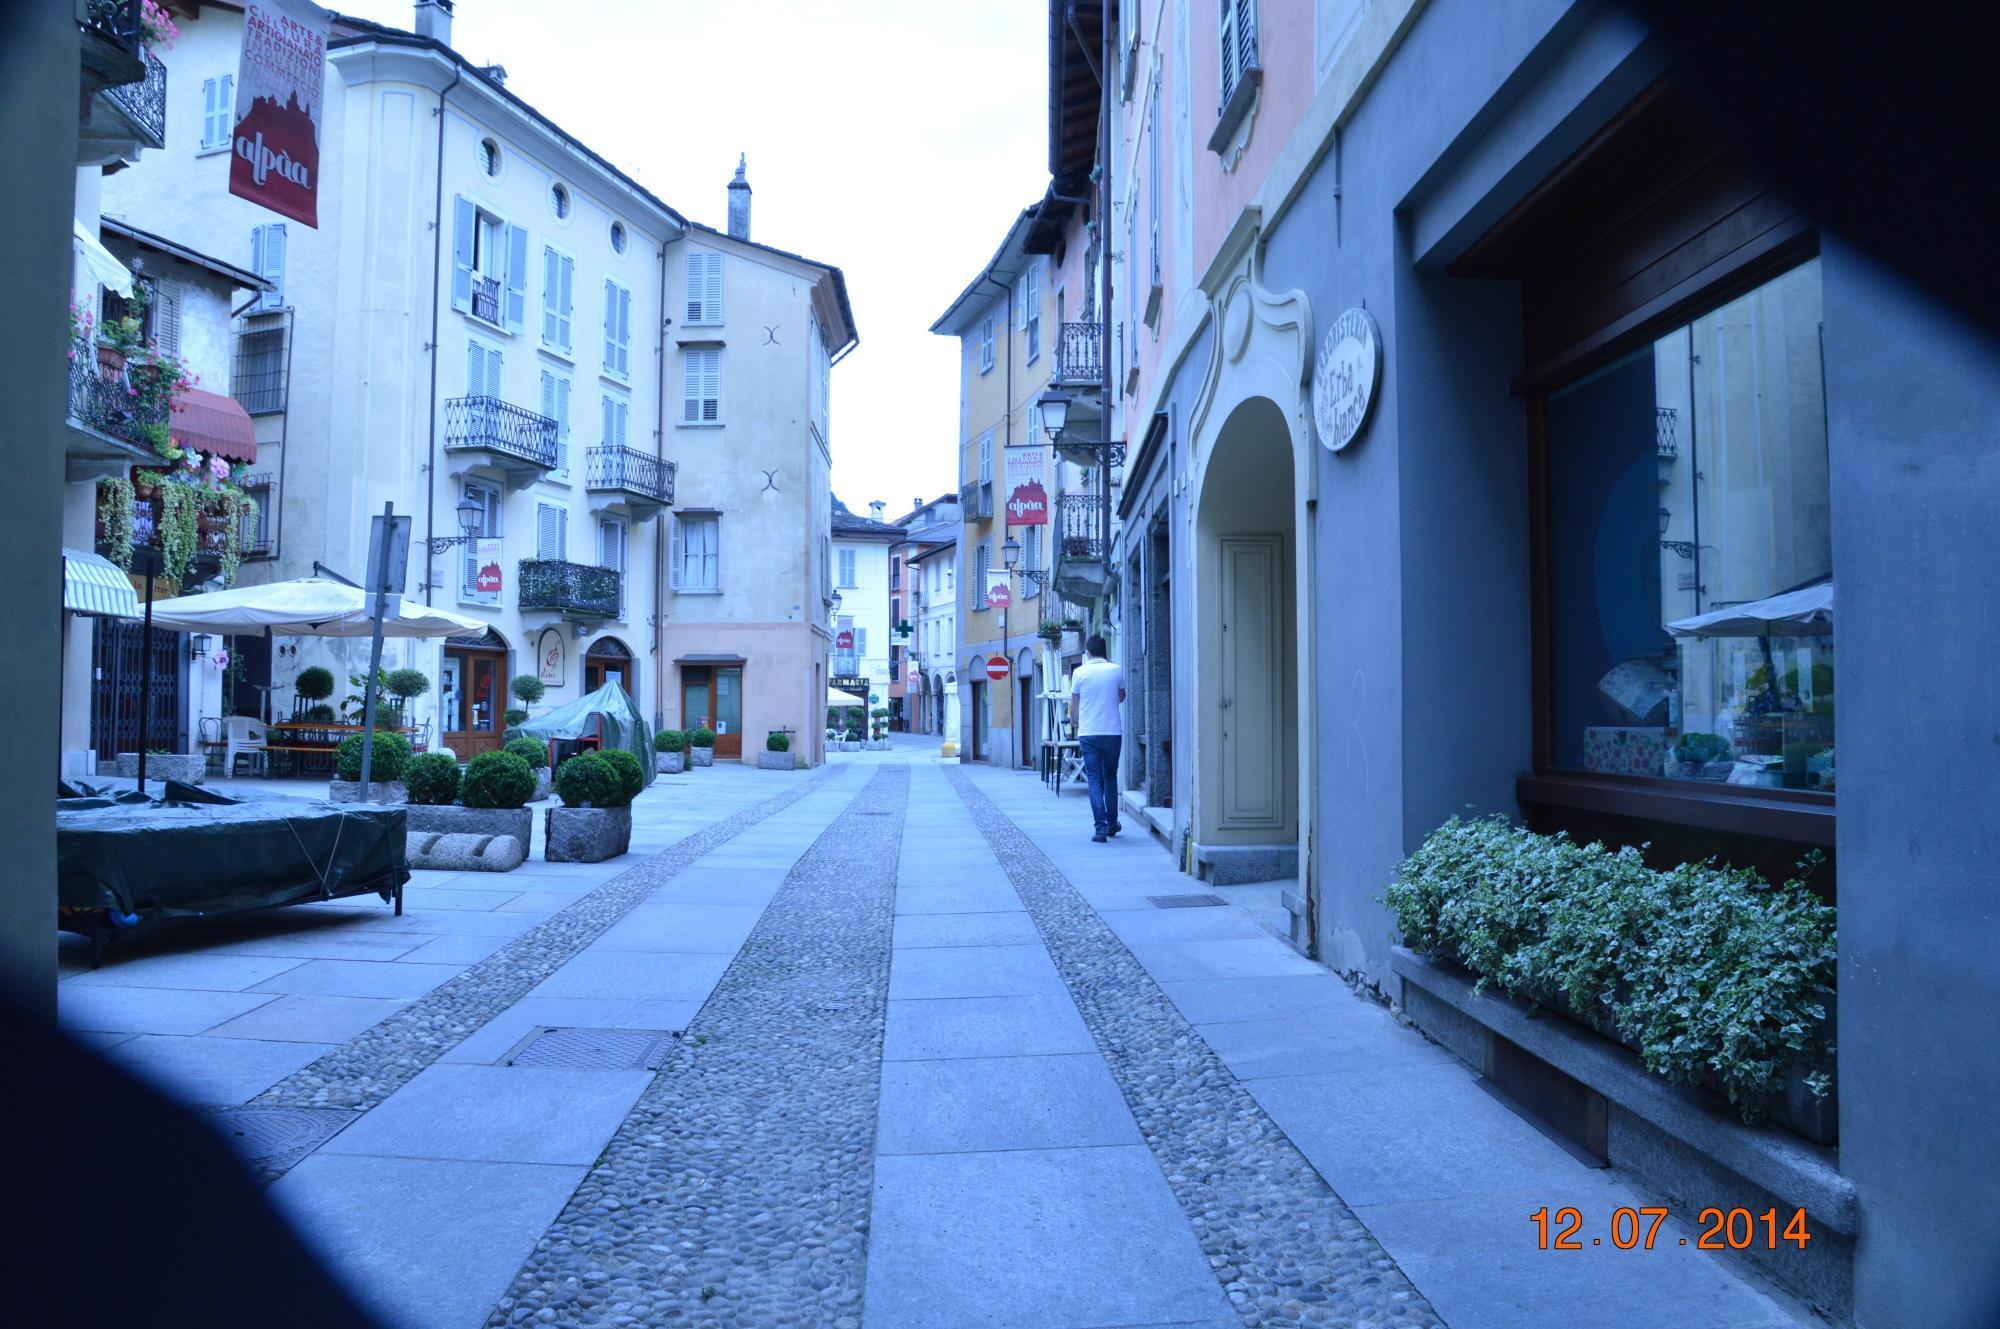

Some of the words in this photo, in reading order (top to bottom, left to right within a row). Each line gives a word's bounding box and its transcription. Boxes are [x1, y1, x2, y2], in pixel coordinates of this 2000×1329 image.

[246, 25, 321, 78] TRADIZIONI
[247, 15, 322, 67] ARTIGIANATO
[248, 4, 322, 58] CULTURA
[244, 49, 320, 98] COMMERCIO
[1329, 360, 1353, 408] Erba
